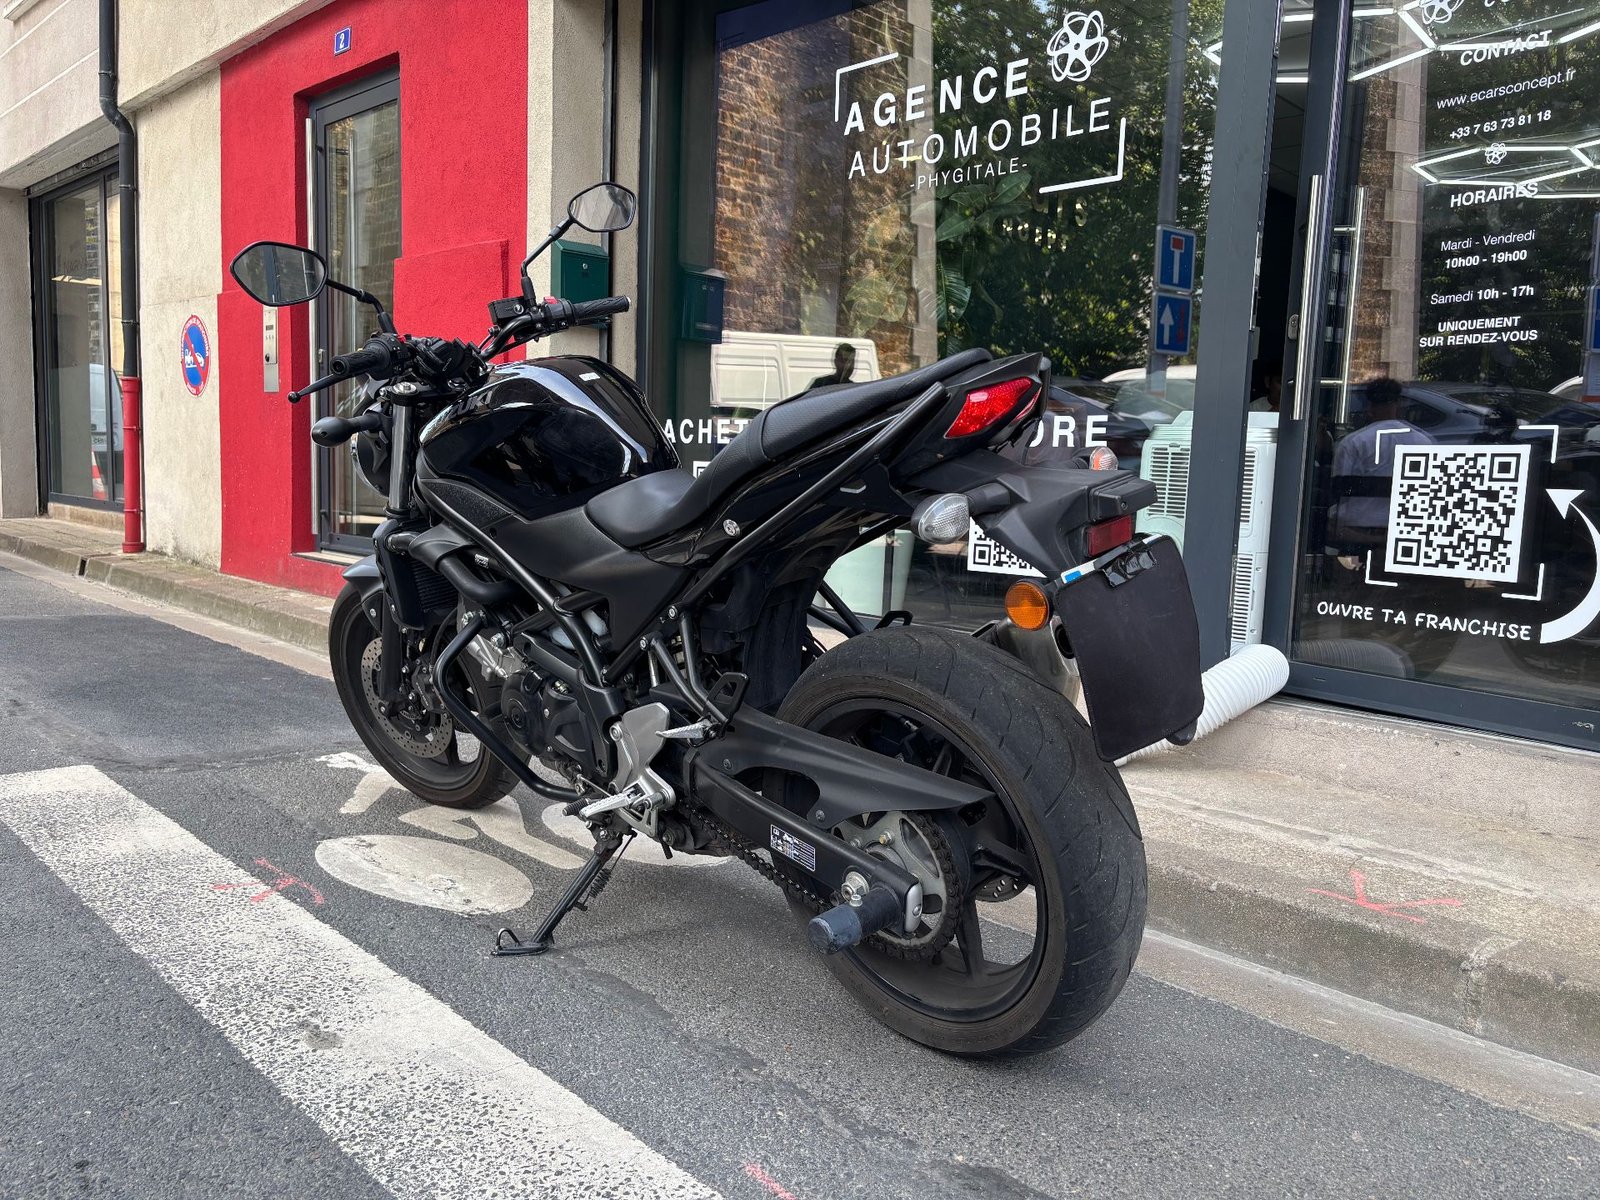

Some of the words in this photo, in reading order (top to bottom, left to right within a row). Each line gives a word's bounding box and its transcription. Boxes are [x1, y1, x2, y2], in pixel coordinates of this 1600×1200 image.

[339, 33, 344, 48] 2
[1460, 30, 1552, 66] CONTACT
[844, 58, 1029, 135] AGENCE
[1437, 69, 1575, 109] www.ecarsconcept.fr
[849, 97, 1111, 179] AUTOMOBILE
[1450, 127, 1470, 140] +33
[1474, 125, 1481, 135] 7
[1483, 121, 1498, 133] 63
[1501, 117, 1515, 130] 73
[1518, 114, 1532, 126] 81
[1537, 110, 1551, 121] 18
[1450, 182, 1538, 208] HORAIRES
[1440, 239, 1472, 251] Mardi
[1483, 230, 1535, 246] Vendredi
[1445, 256, 1479, 269] 10h00
[1490, 250, 1527, 264] 19h00
[1430, 291, 1473, 305] Samedi
[1477, 289, 1499, 301] 10h
[1511, 285, 1534, 298] 17h
[1437, 316, 1521, 332] UNIQUEMENT
[1419, 337, 1443, 348] SUR
[1447, 329, 1538, 346] RENDEZ-VOUS
[664, 418, 749, 444] ACHET
[1316, 601, 1374, 621] OUVRE
[1381, 609, 1407, 625] TA
[1414, 612, 1531, 641] FRANCHISE
